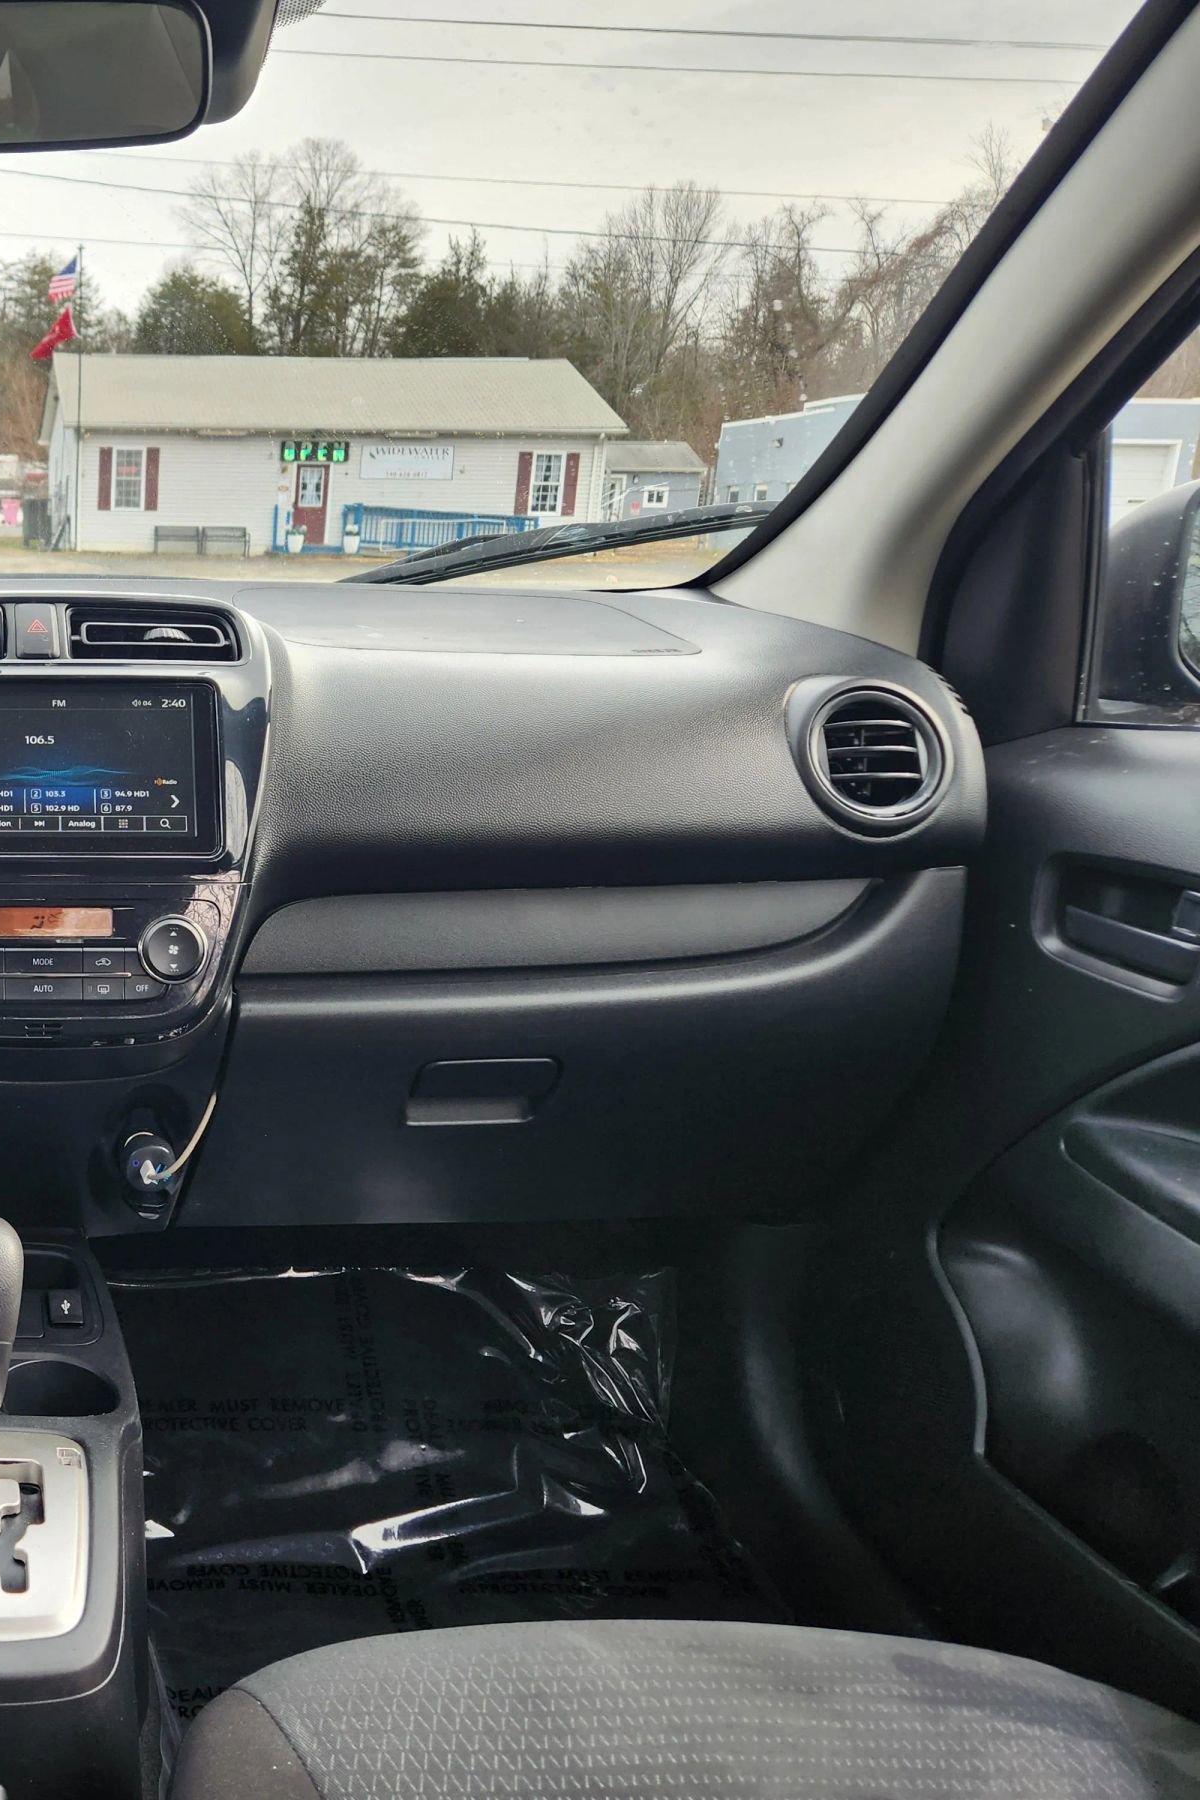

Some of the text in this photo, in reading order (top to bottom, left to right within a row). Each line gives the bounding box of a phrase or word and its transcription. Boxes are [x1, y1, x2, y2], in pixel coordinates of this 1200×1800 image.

[283, 441, 345, 462] OPEN
[52, 699, 66, 708] FM
[161, 698, 187, 708] 2:40
[24, 735, 55, 745] 106.5
[68, 820, 96, 829] Analog
[31, 958, 54, 967] MODE
[33, 984, 54, 993] AUTO
[135, 984, 149, 993] OFF
[143, 1416, 240, 1431] ROTECTIVE
[238, 1579, 290, 1594] MUST
